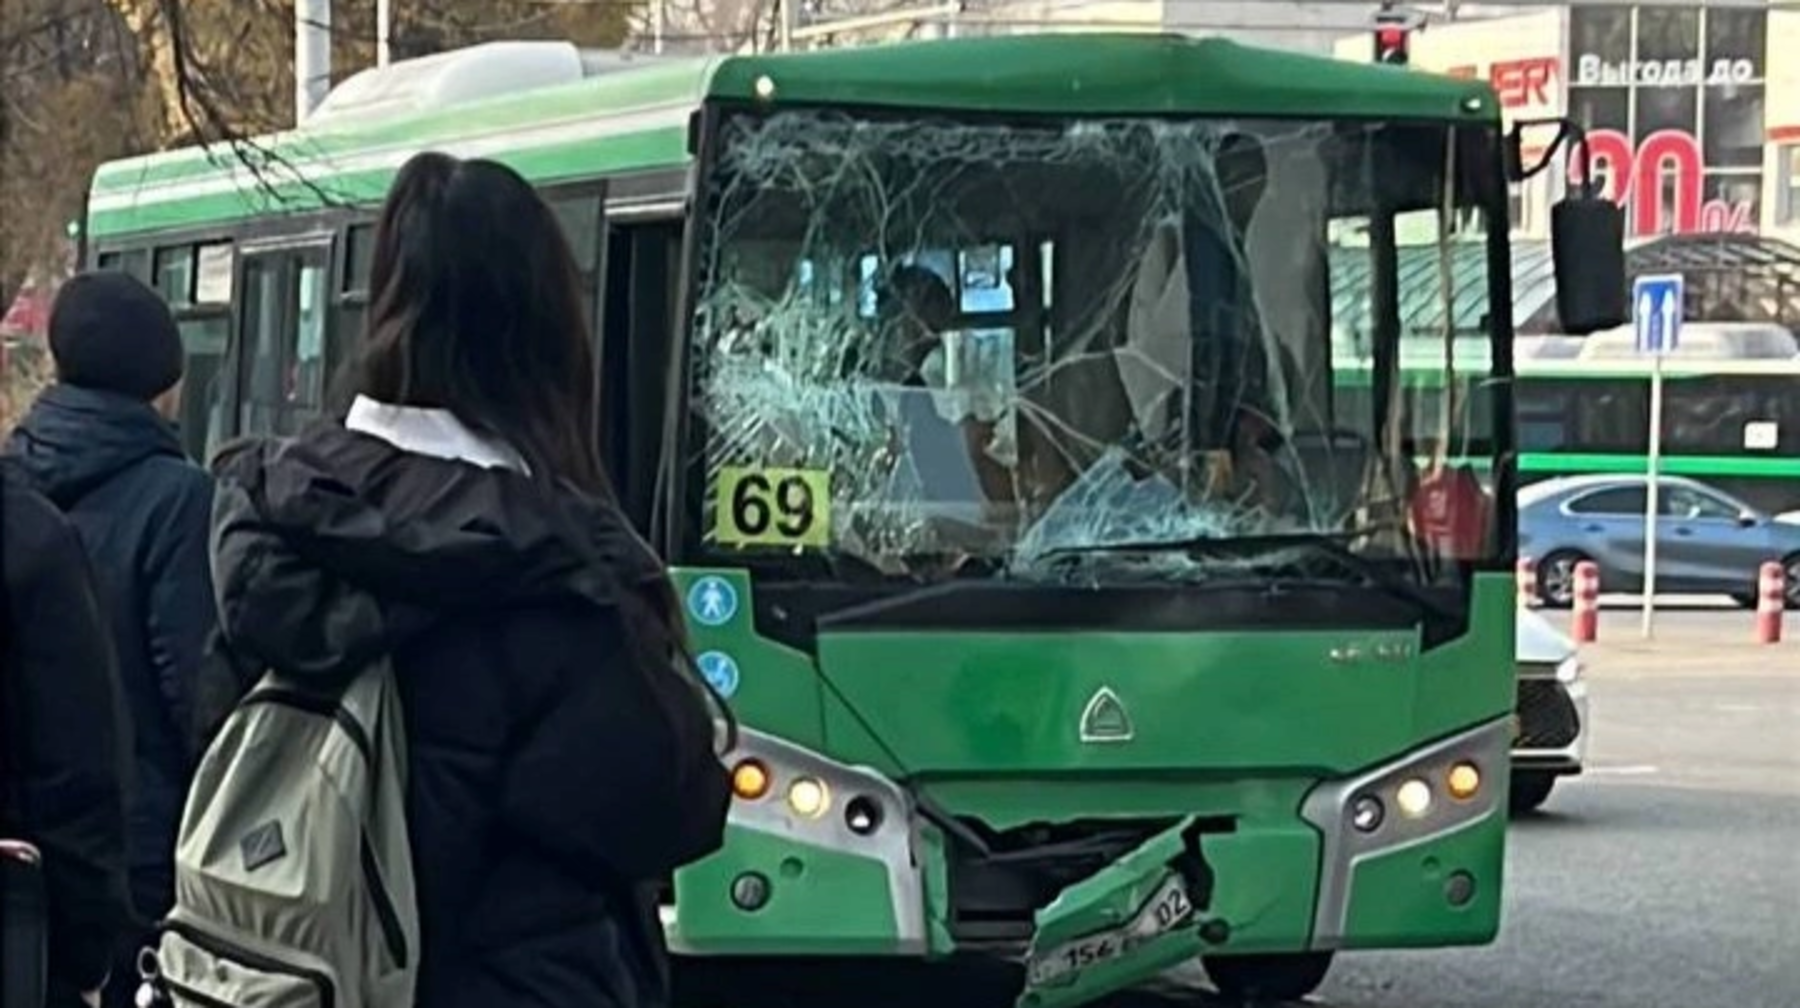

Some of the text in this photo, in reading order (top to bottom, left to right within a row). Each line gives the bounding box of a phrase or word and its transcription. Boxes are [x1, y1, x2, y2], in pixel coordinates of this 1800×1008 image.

[1578, 53, 1754, 88] Выгода до
[732, 474, 814, 537] 69
